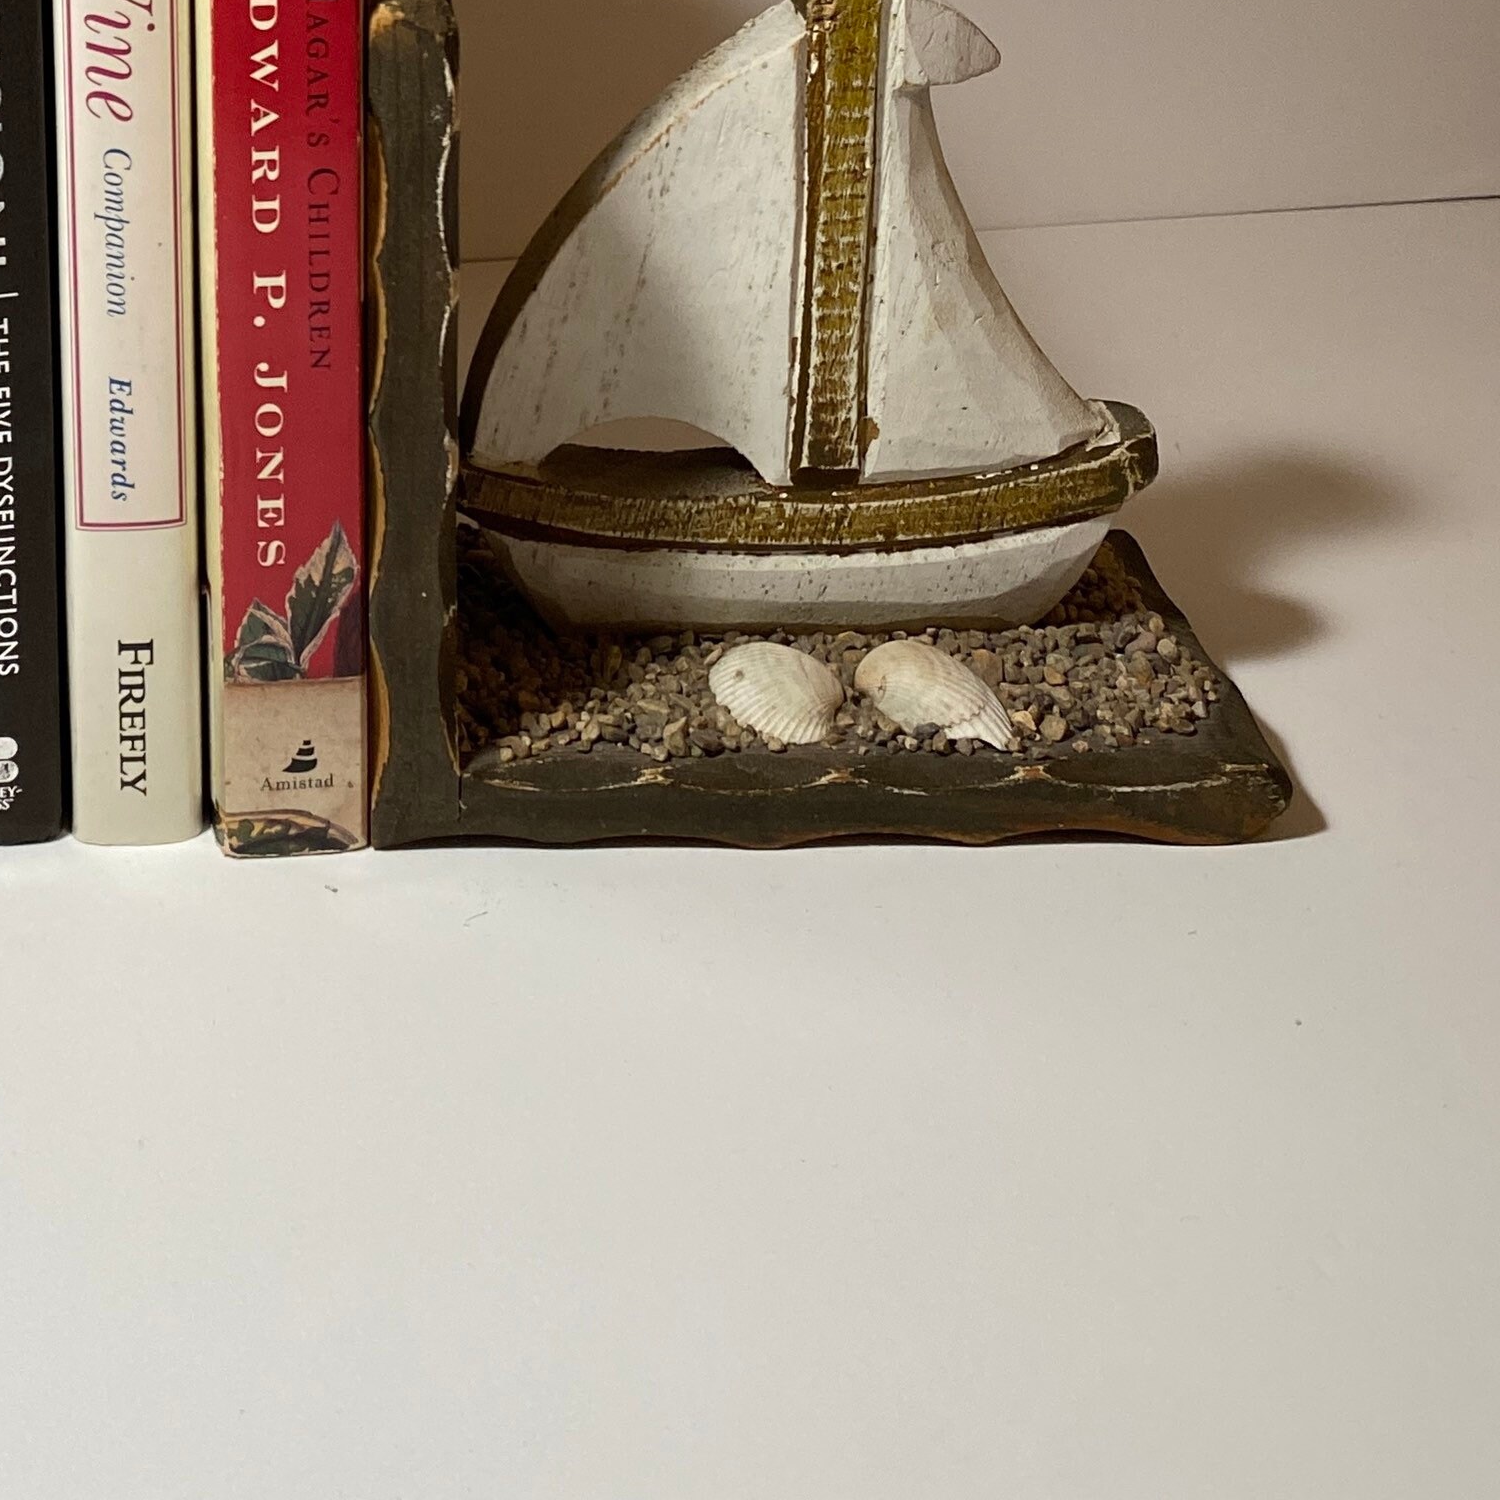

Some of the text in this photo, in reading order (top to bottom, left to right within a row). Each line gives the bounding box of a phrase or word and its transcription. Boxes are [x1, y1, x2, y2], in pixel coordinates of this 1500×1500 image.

[94, 147, 135, 318] Companion
[253, 271, 287, 328] P.
[108, 376, 135, 502] Edwards
[253, 362, 288, 568] JONES
[260, 773, 334, 791] Amistad
